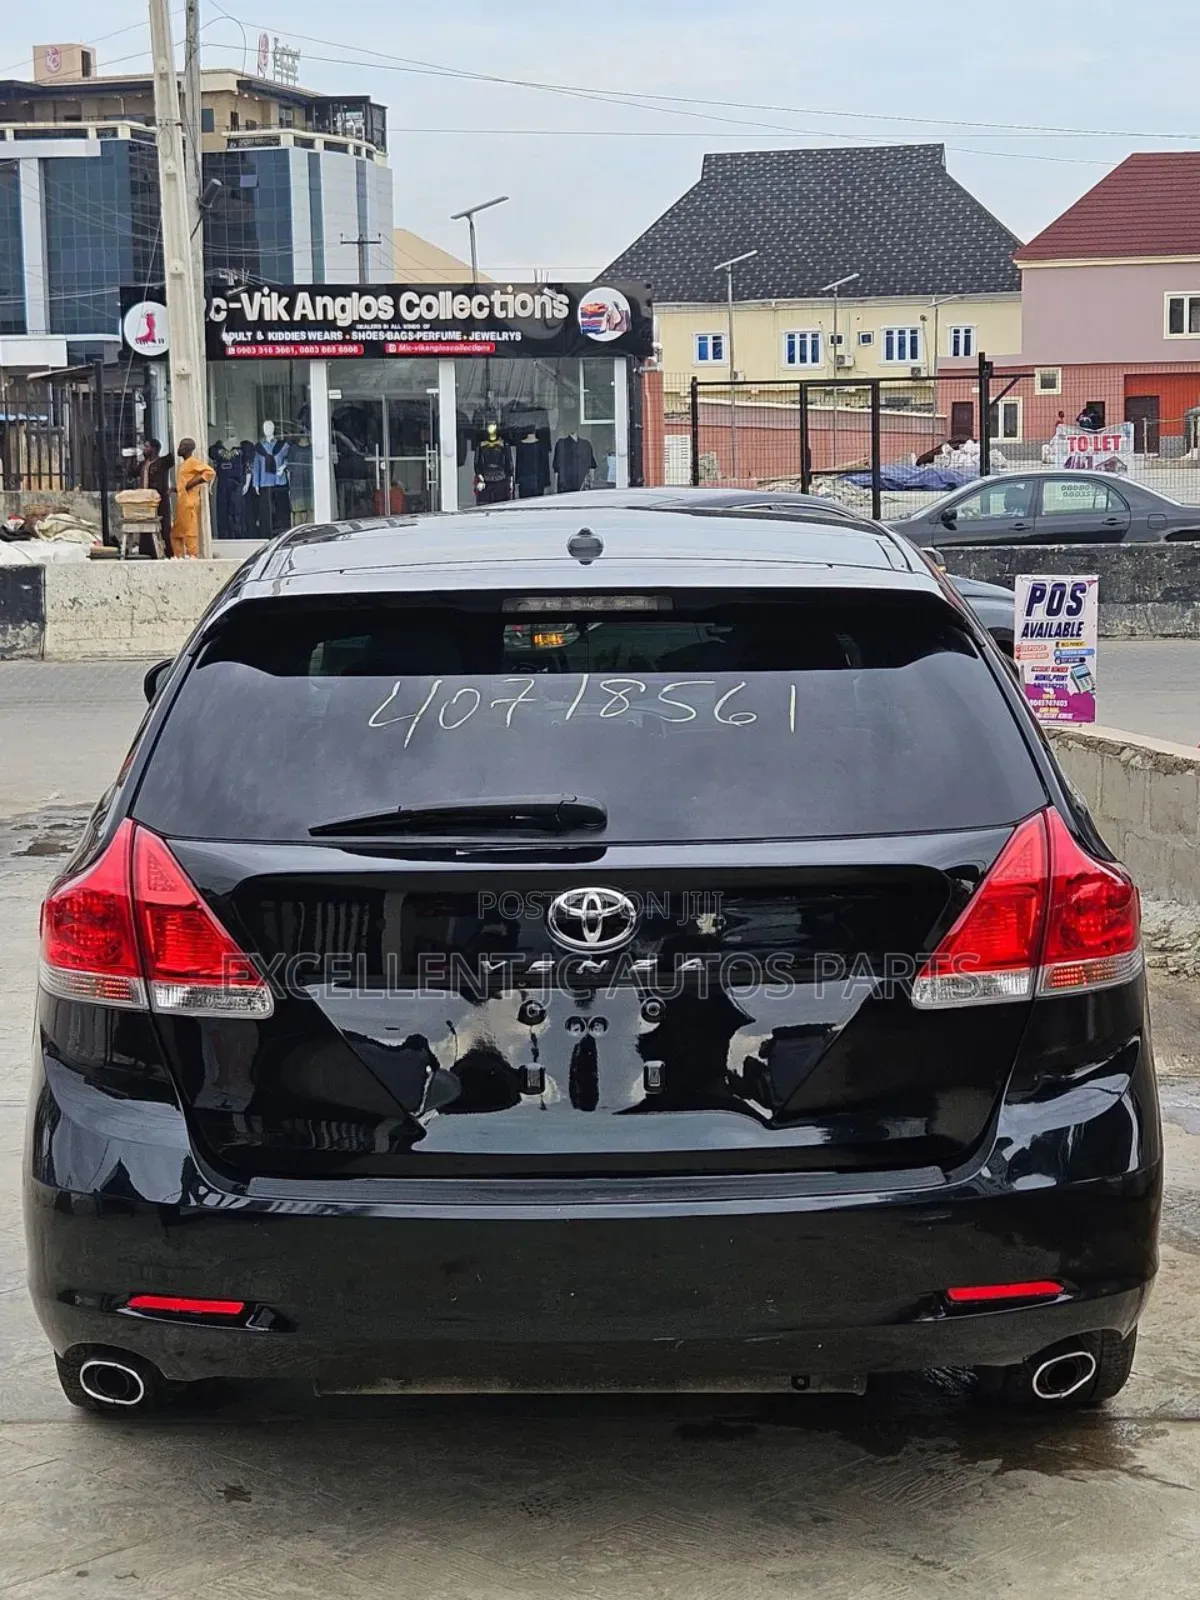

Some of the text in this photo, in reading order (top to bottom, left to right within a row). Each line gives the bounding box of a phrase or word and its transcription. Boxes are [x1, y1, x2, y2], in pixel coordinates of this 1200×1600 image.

[293, 290, 395, 327] Anglos
[399, 284, 570, 321] Collections
[256, 331, 265, 341] &
[268, 331, 306, 341] KIDDIES
[307, 331, 343, 341] WEARS
[469, 331, 522, 341] JEWELRYS
[1067, 434, 1122, 452] TO LET
[1025, 583, 1087, 617] POS
[1021, 621, 1085, 639] AVAILABLE
